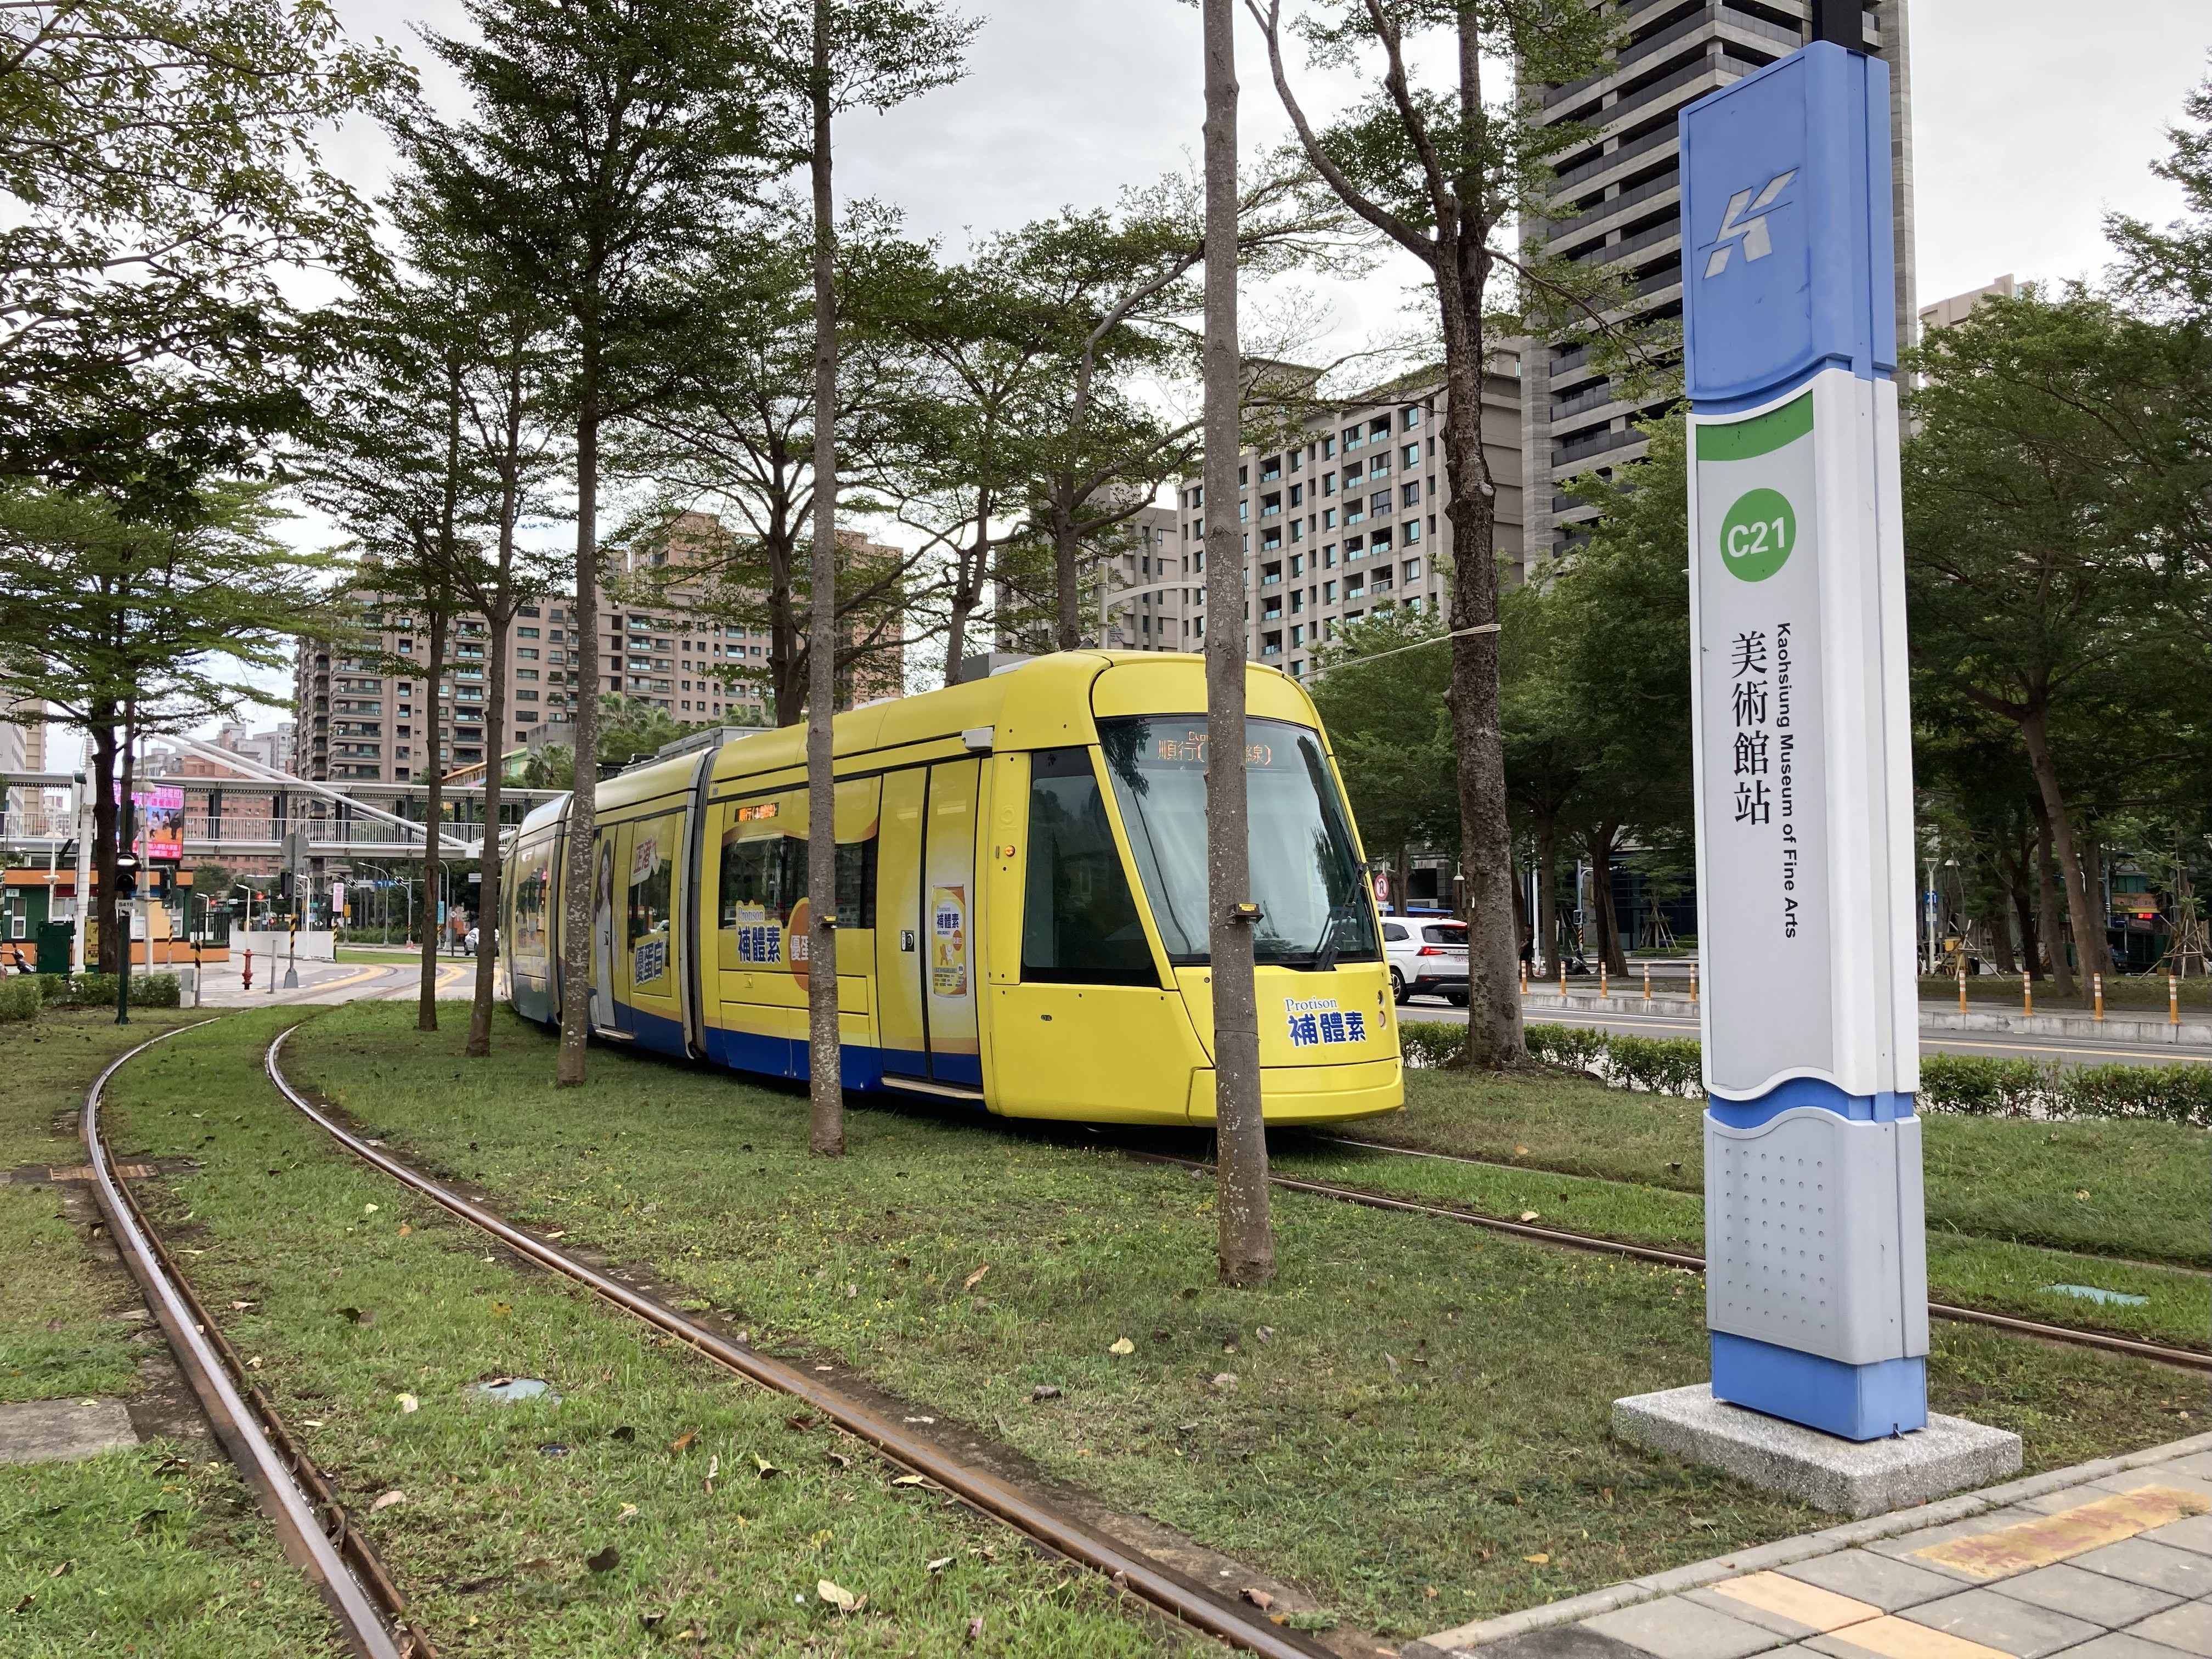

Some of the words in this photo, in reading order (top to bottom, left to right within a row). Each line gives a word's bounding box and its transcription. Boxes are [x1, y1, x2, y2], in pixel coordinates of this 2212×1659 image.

[1727, 516, 1785, 558] C21
[1776, 622, 1792, 728] Kaohsiung
[1731, 630, 1771, 825] 美術館站
[1780, 734, 1794, 817] Museum
[1783, 823, 1797, 843] of
[1783, 849, 1797, 891] Fine
[738, 905, 764, 921] Protison
[936, 913, 959, 928] 補體素
[1785, 896, 1798, 938] Arts
[635, 939, 664, 985] 優蛋白
[738, 925, 781, 963] 補體素
[791, 934, 809, 961] 優蛋
[1285, 996, 1338, 1012] Protison
[1288, 1011, 1366, 1047] 補體素
